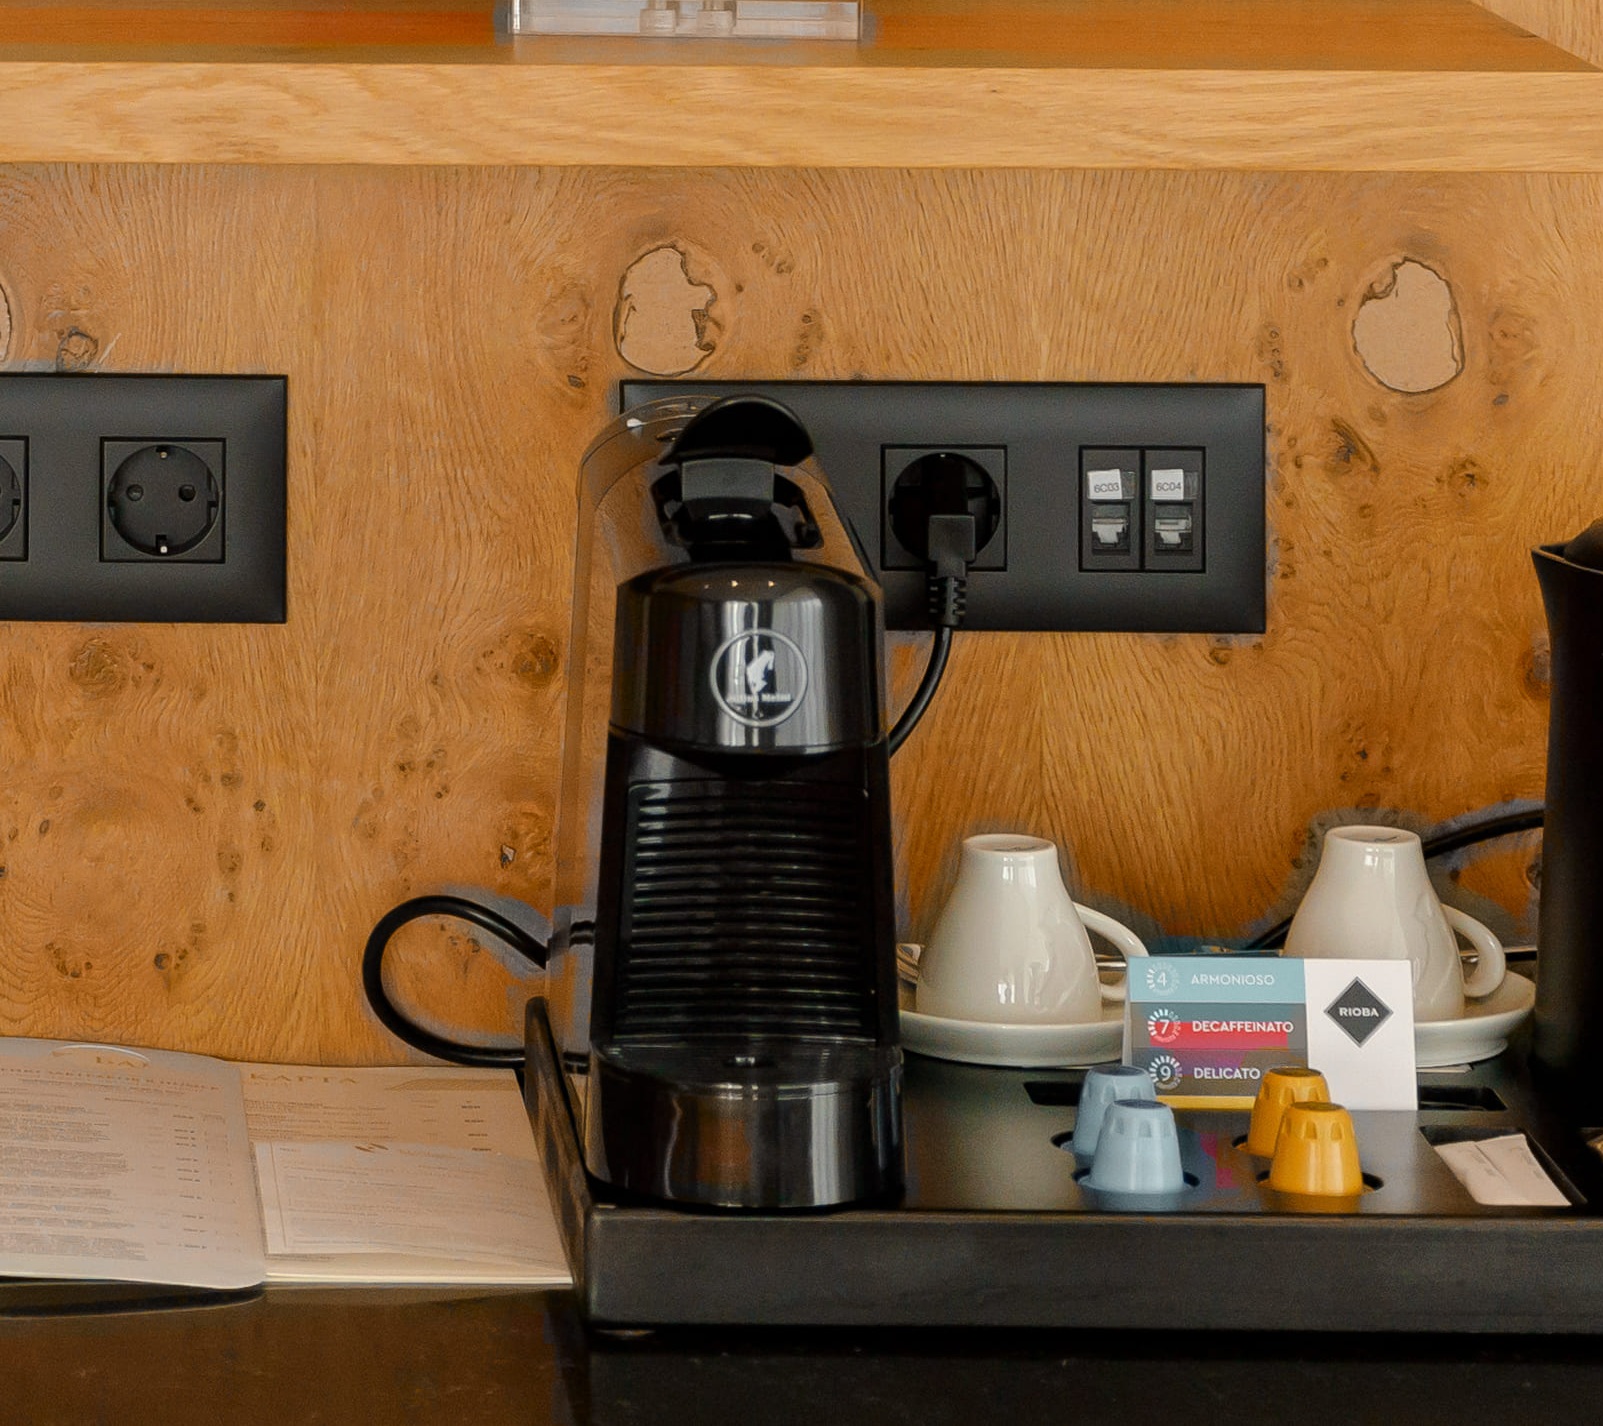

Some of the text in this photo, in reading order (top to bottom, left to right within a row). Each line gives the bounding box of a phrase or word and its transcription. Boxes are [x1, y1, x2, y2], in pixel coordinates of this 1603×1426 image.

[1156, 481, 1182, 492] 6C04
[1156, 972, 1276, 987] 4 ARMONIOSO
[1338, 1006, 1380, 1018] RIOBA
[1159, 1019, 1294, 1035] 7 DECAFFEINATO
[1159, 1065, 1261, 1081] 9 DELICATO
